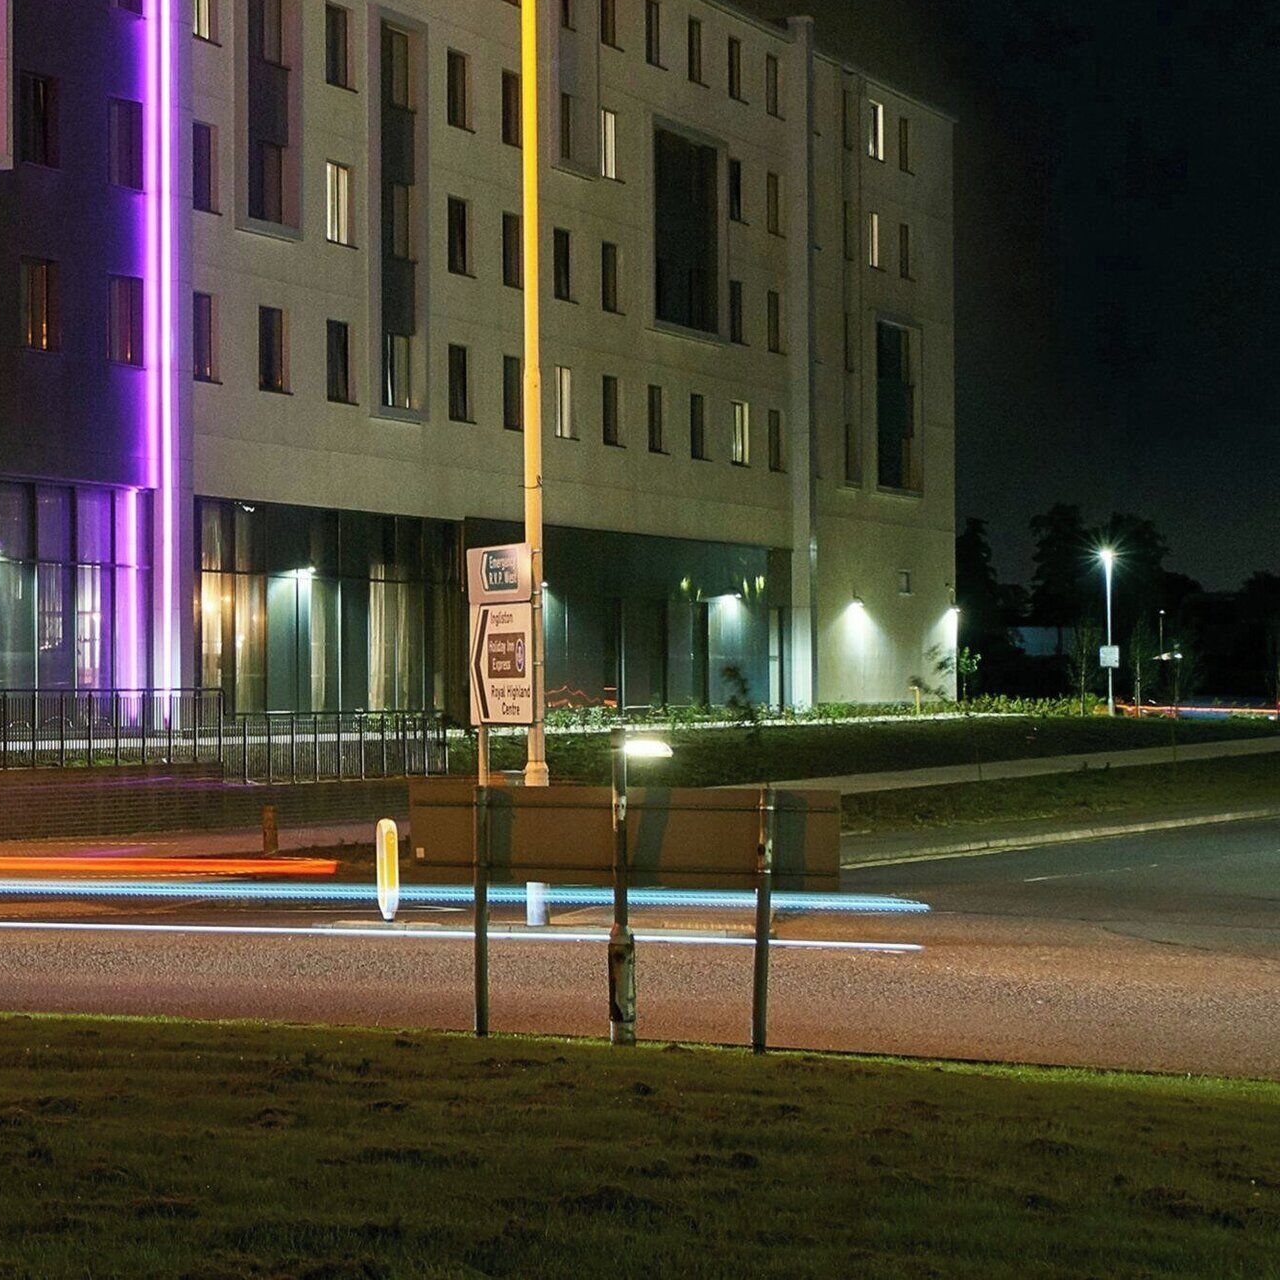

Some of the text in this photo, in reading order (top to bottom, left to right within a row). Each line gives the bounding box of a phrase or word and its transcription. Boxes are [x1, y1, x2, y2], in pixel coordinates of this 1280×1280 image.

[489, 640, 506, 655] Holiday
[492, 658, 511, 672] Express
[491, 685, 531, 701] Royal Highland
[502, 702, 520, 716] Centre
